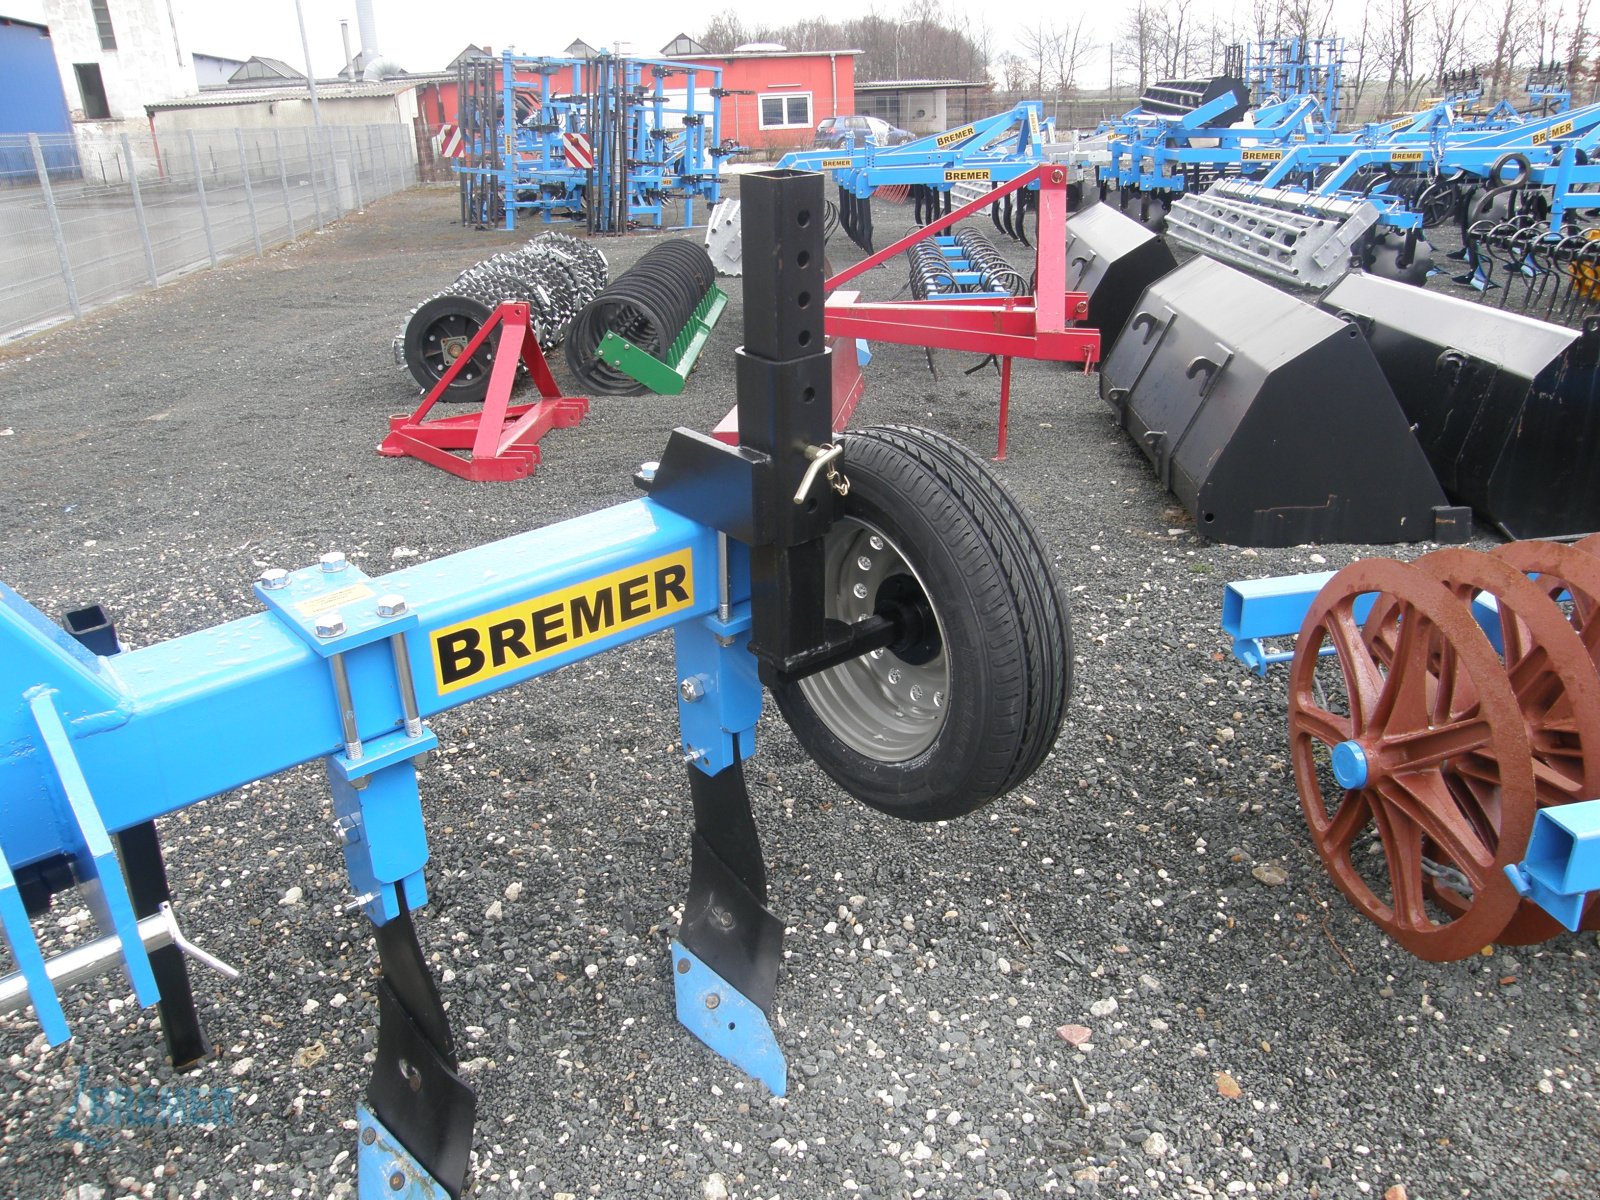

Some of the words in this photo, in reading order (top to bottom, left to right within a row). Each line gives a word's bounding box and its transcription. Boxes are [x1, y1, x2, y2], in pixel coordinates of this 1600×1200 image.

[936, 127, 974, 146] BREMER
[1532, 122, 1572, 145] BRMER
[1242, 151, 1281, 160] BREMER
[1391, 152, 1422, 160] BREMER
[822, 159, 851, 167] BREMER
[945, 171, 989, 180] BREMER
[437, 564, 690, 686] BREMER
